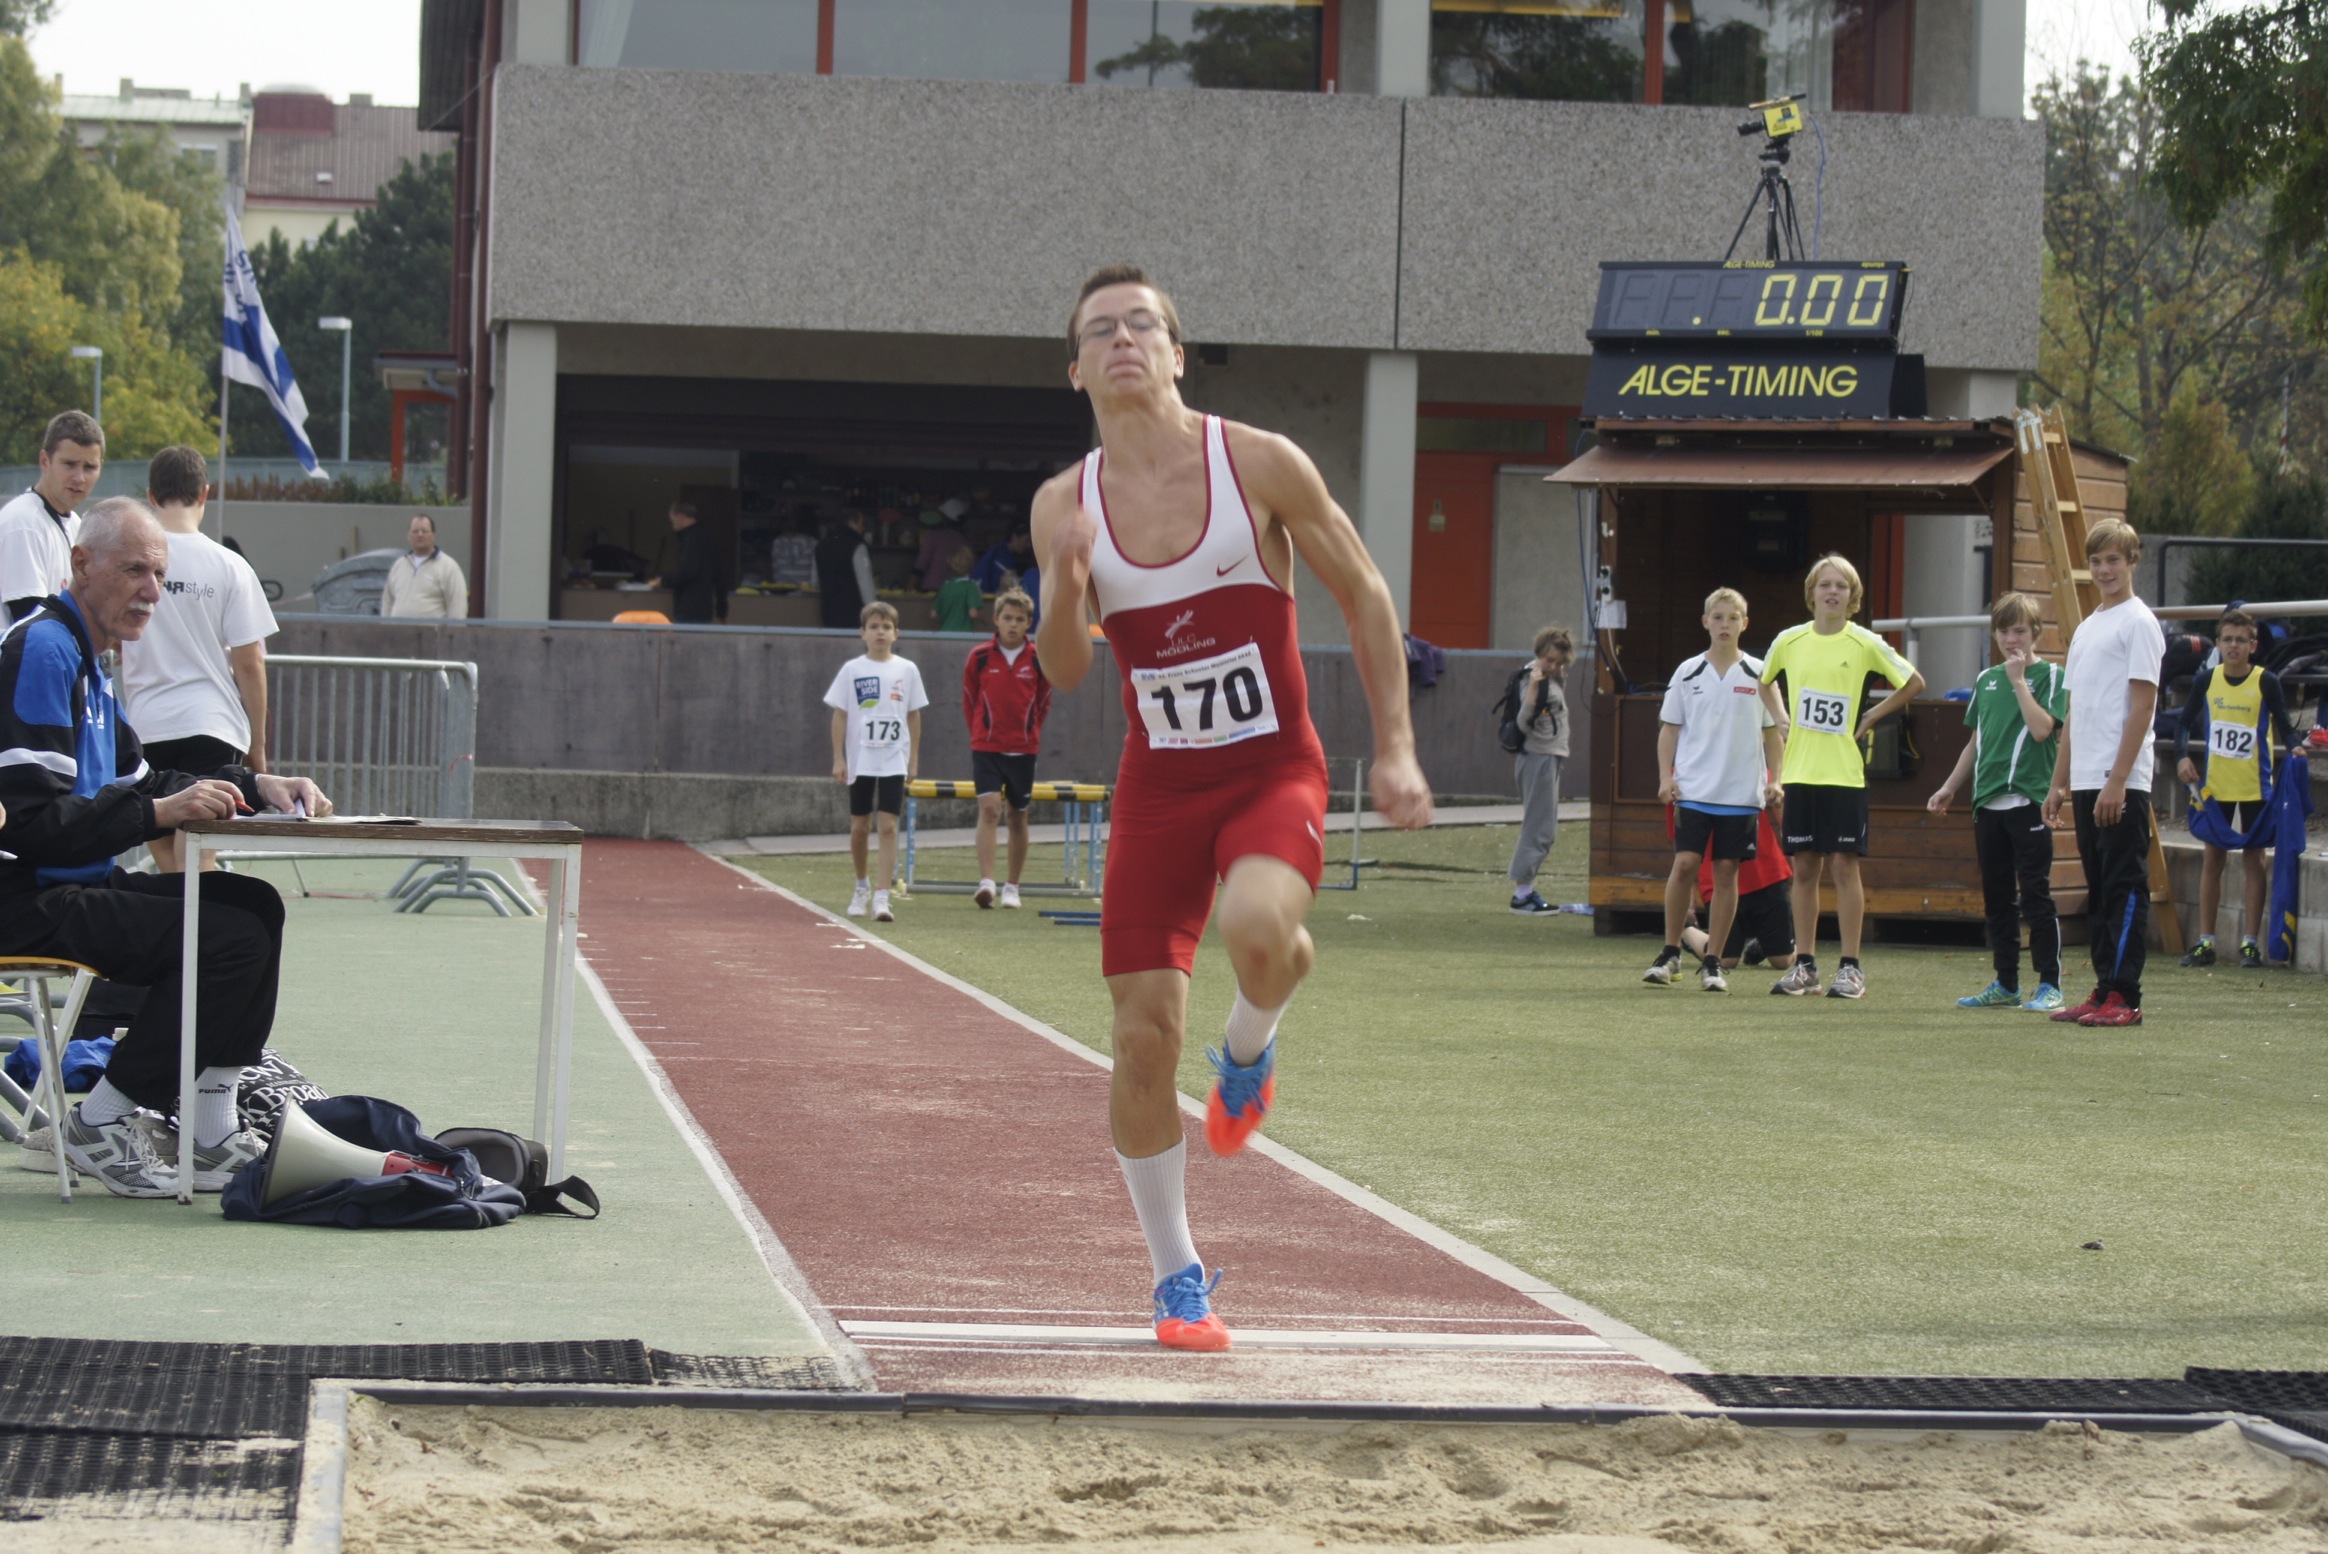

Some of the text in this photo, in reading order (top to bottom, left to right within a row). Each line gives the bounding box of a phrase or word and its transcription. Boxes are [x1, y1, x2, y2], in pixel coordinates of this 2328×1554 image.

[1722, 260, 1775, 268] ALGE-TIMING
[1618, 365, 1858, 397] ALGE-TIMING
[855, 679, 878, 689] RIVER
[861, 687, 878, 695] SIDE
[1151, 666, 1263, 731] 170
[1803, 696, 1845, 727] 153
[865, 720, 902, 741] 173
[2214, 728, 2252, 753] 182
